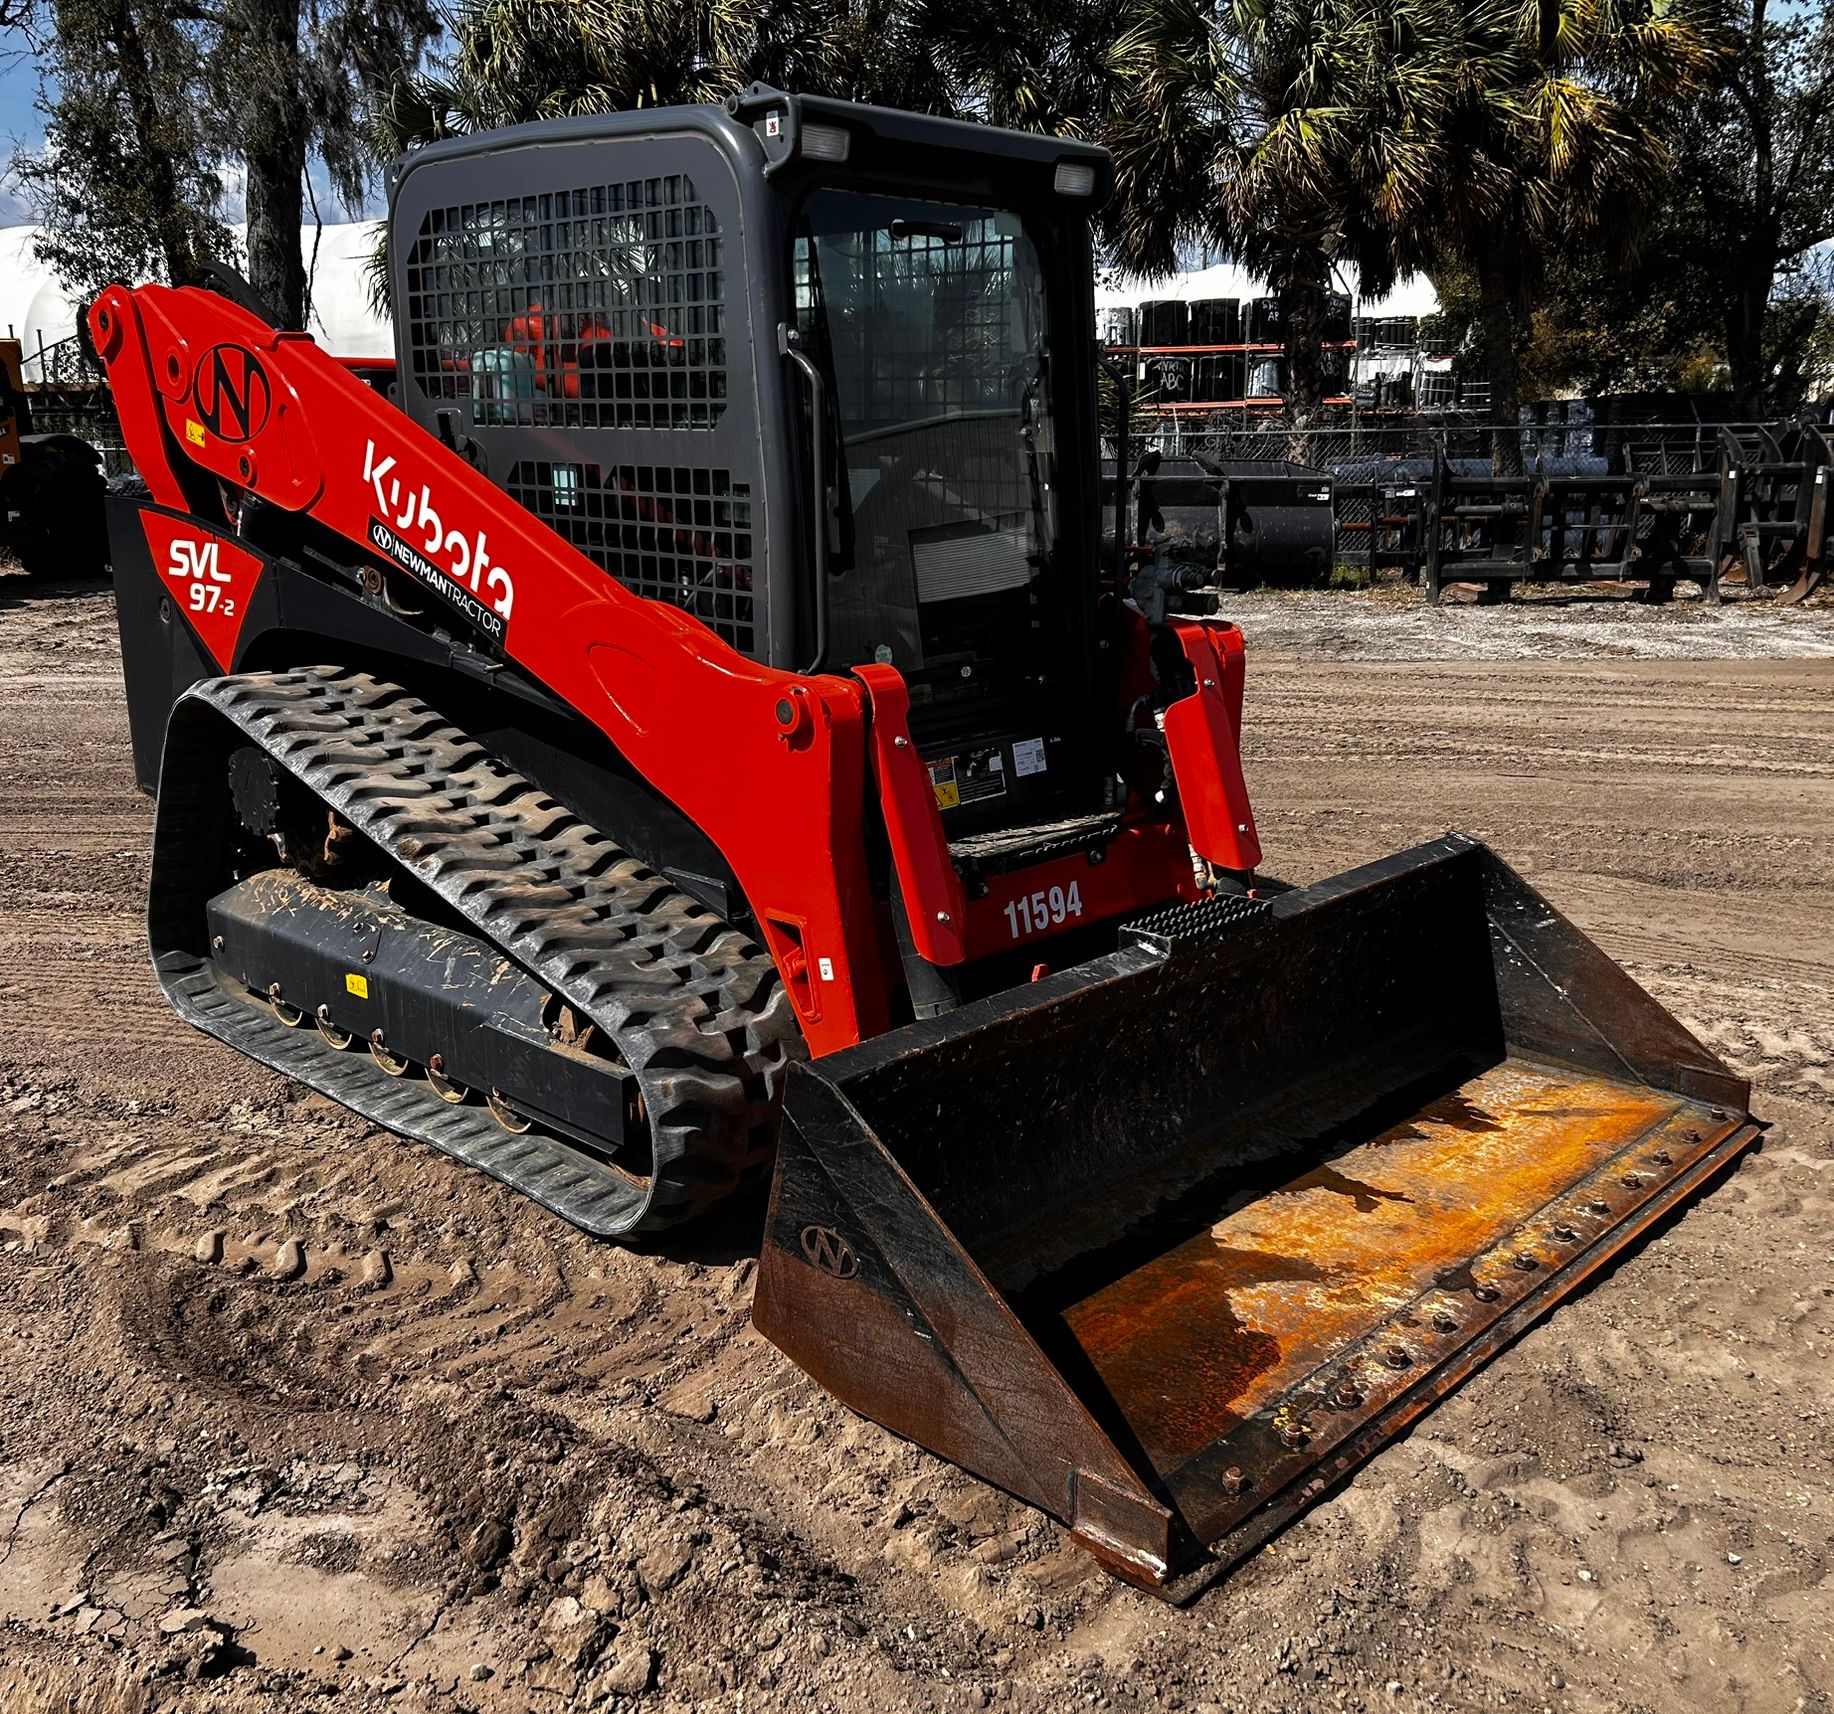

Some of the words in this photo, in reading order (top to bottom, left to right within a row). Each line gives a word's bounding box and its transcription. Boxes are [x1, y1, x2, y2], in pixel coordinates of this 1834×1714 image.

[1160, 372, 1184, 391] ABC
[362, 438, 514, 621] Kubota
[168, 539, 232, 583] SVL
[1003, 880, 1083, 939] 11594
